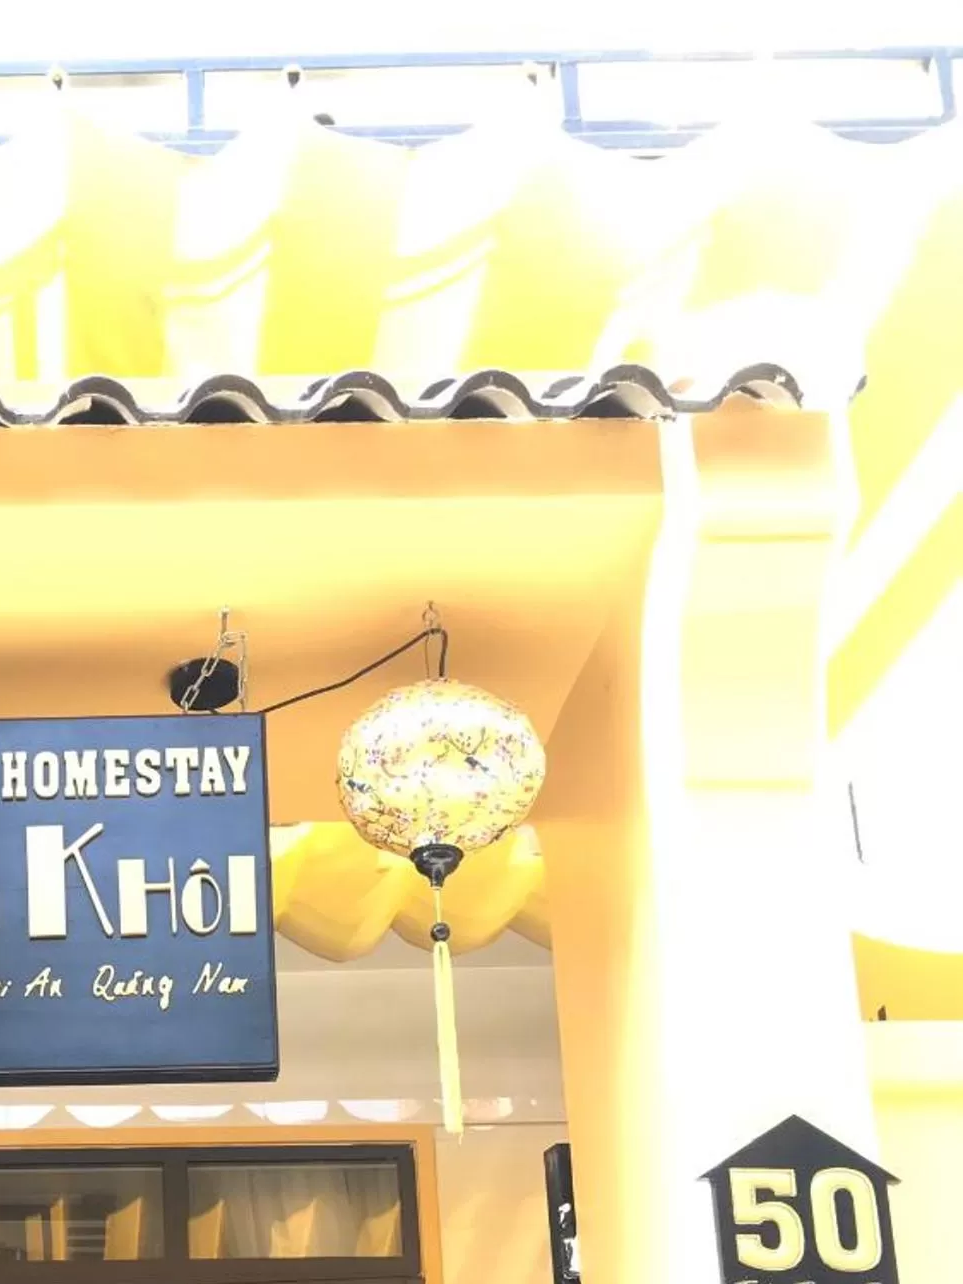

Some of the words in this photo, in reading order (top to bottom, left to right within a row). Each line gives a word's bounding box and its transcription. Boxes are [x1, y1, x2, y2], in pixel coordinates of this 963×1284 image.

[0, 745, 251, 800] HOMESTAY
[25, 822, 258, 940] KHÔI
[24, 966, 64, 999] An
[192, 961, 250, 995] Nam
[729, 1167, 882, 1272] 50
